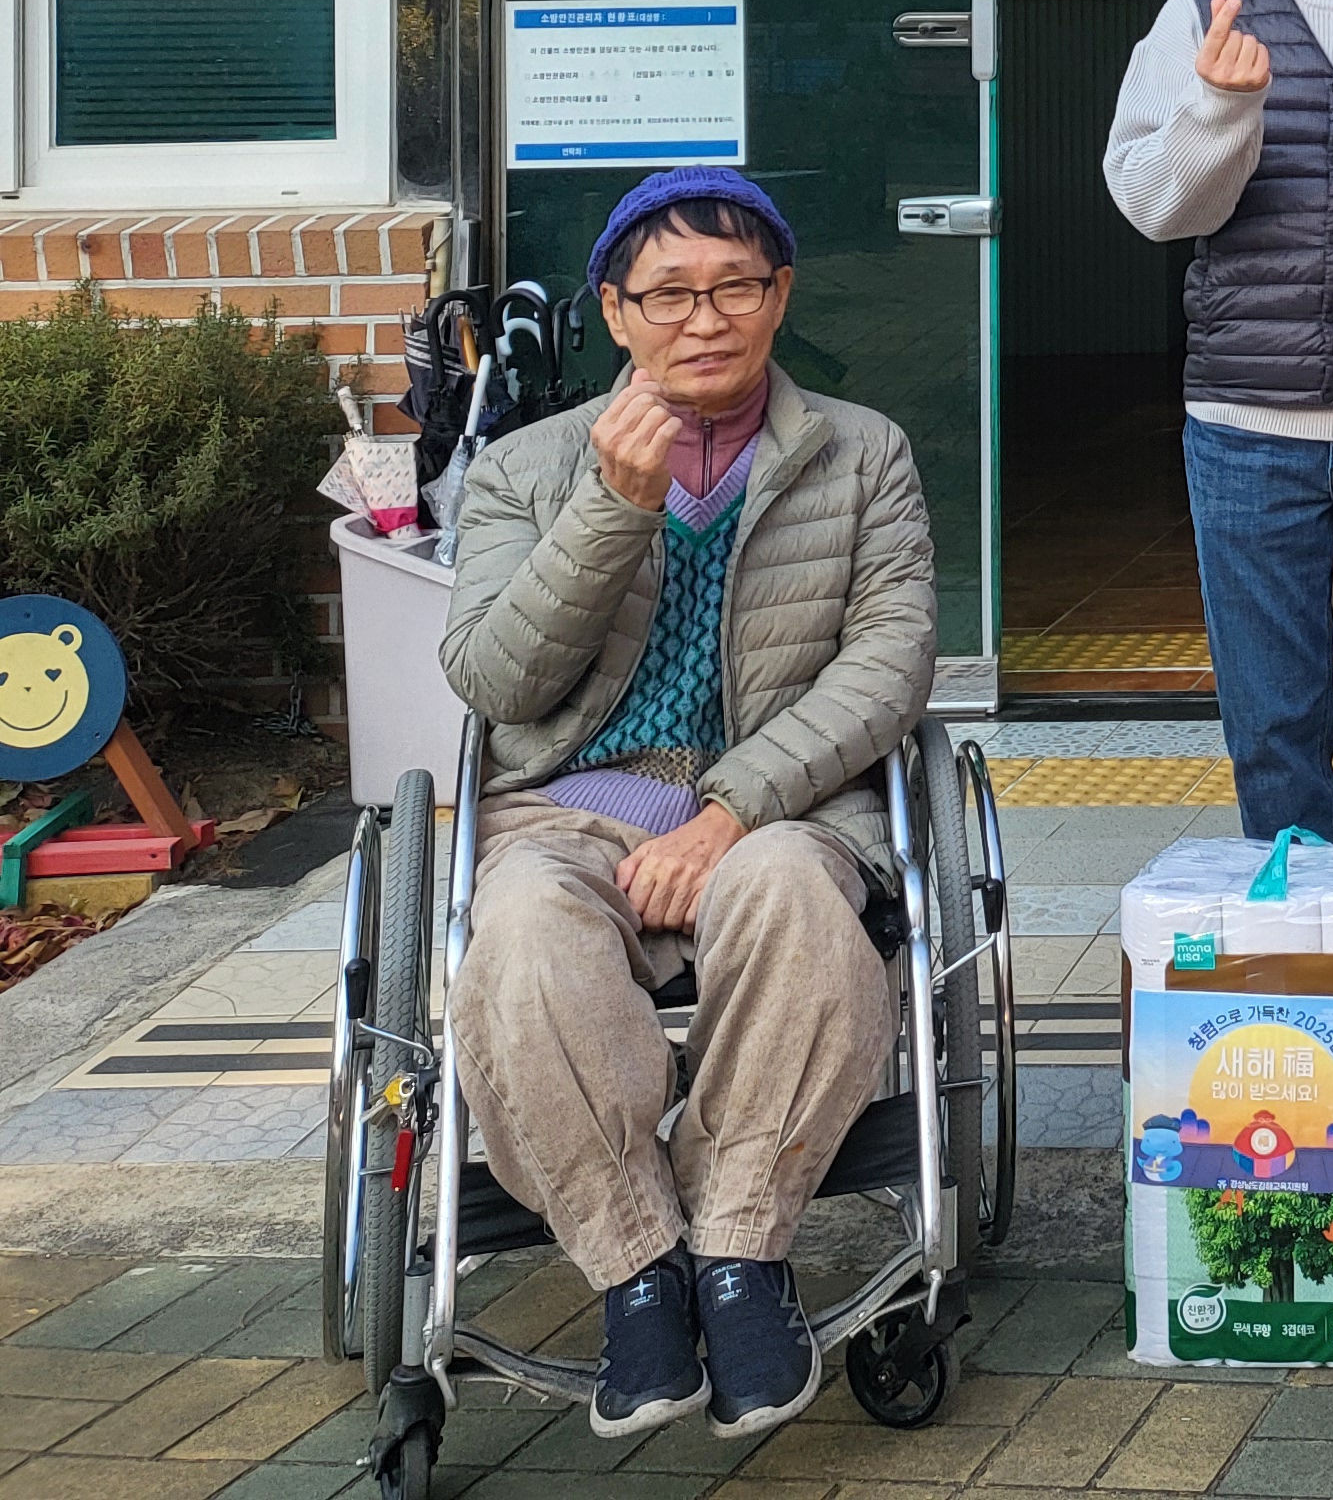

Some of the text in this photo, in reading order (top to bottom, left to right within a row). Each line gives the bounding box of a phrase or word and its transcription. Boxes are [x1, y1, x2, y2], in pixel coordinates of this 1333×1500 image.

[541, 13, 602, 23] 소방안전관리자
[1177, 943, 1212, 954] mona
[1187, 1008, 1244, 1051] 청렴으로
[1247, 1005, 1290, 1022] 가득찬
[1215, 1046, 1315, 1079] 새해 福
[1211, 1082, 1318, 1103] 많이 받으세요!
[1187, 1304, 1216, 1316] 친환경
